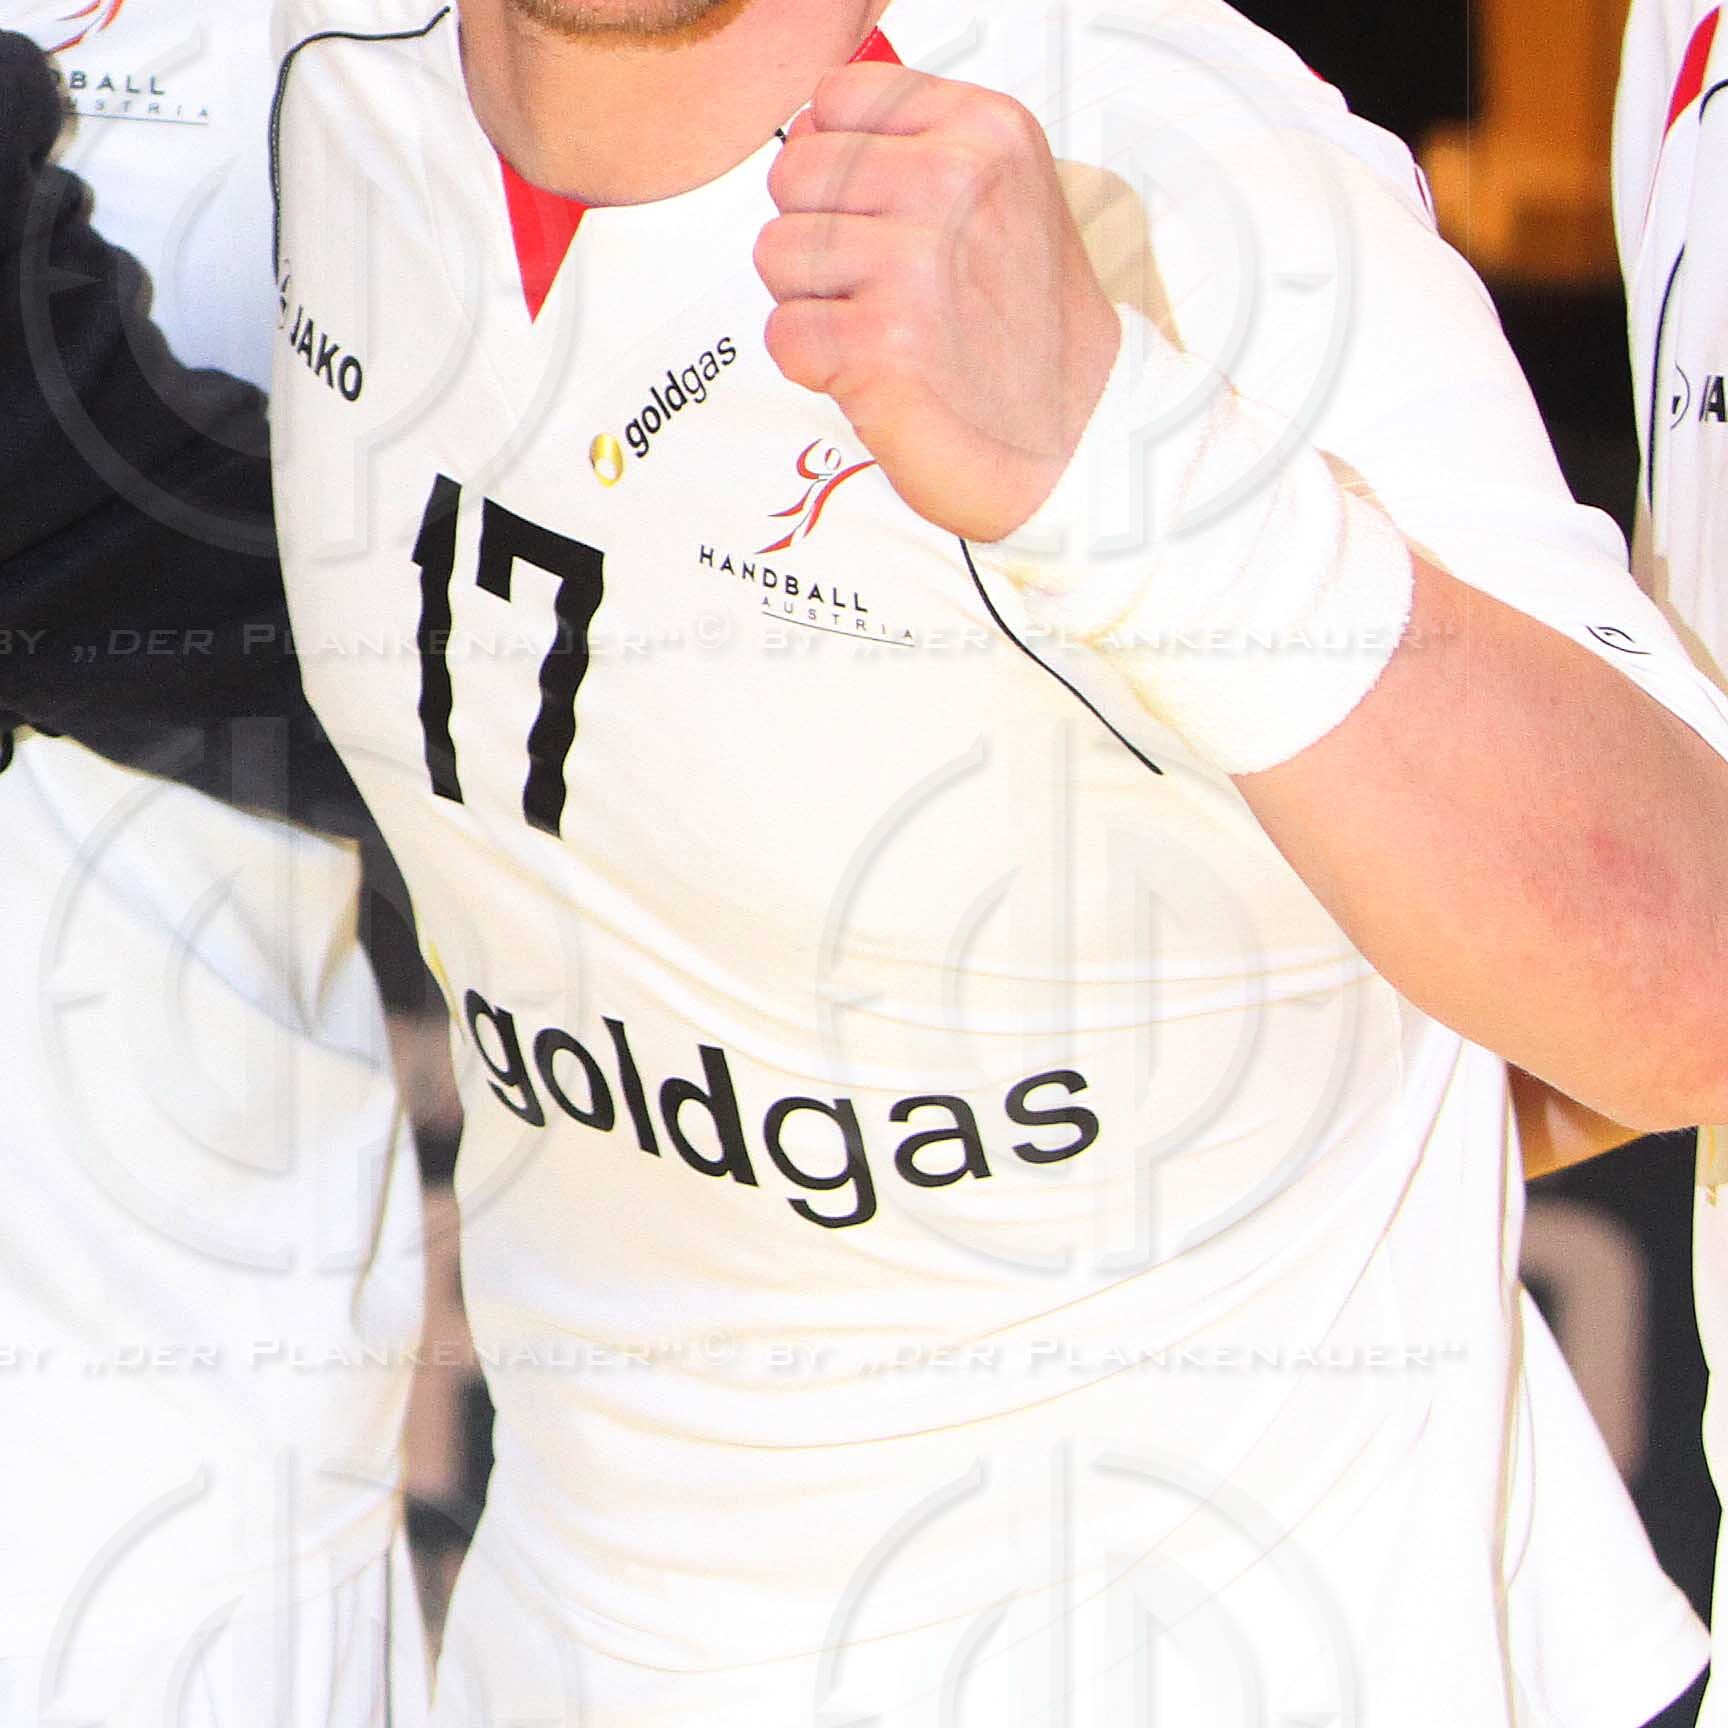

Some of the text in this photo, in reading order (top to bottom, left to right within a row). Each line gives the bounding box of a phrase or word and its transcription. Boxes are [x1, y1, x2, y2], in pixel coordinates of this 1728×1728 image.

[290, 304, 362, 402] JAKO
[625, 336, 738, 458] goldgas
[699, 544, 868, 613] HANDBALL
[761, 596, 913, 640] AUSTRIA
[411, 473, 605, 840] 17
[464, 989, 1101, 1229] goldgas
